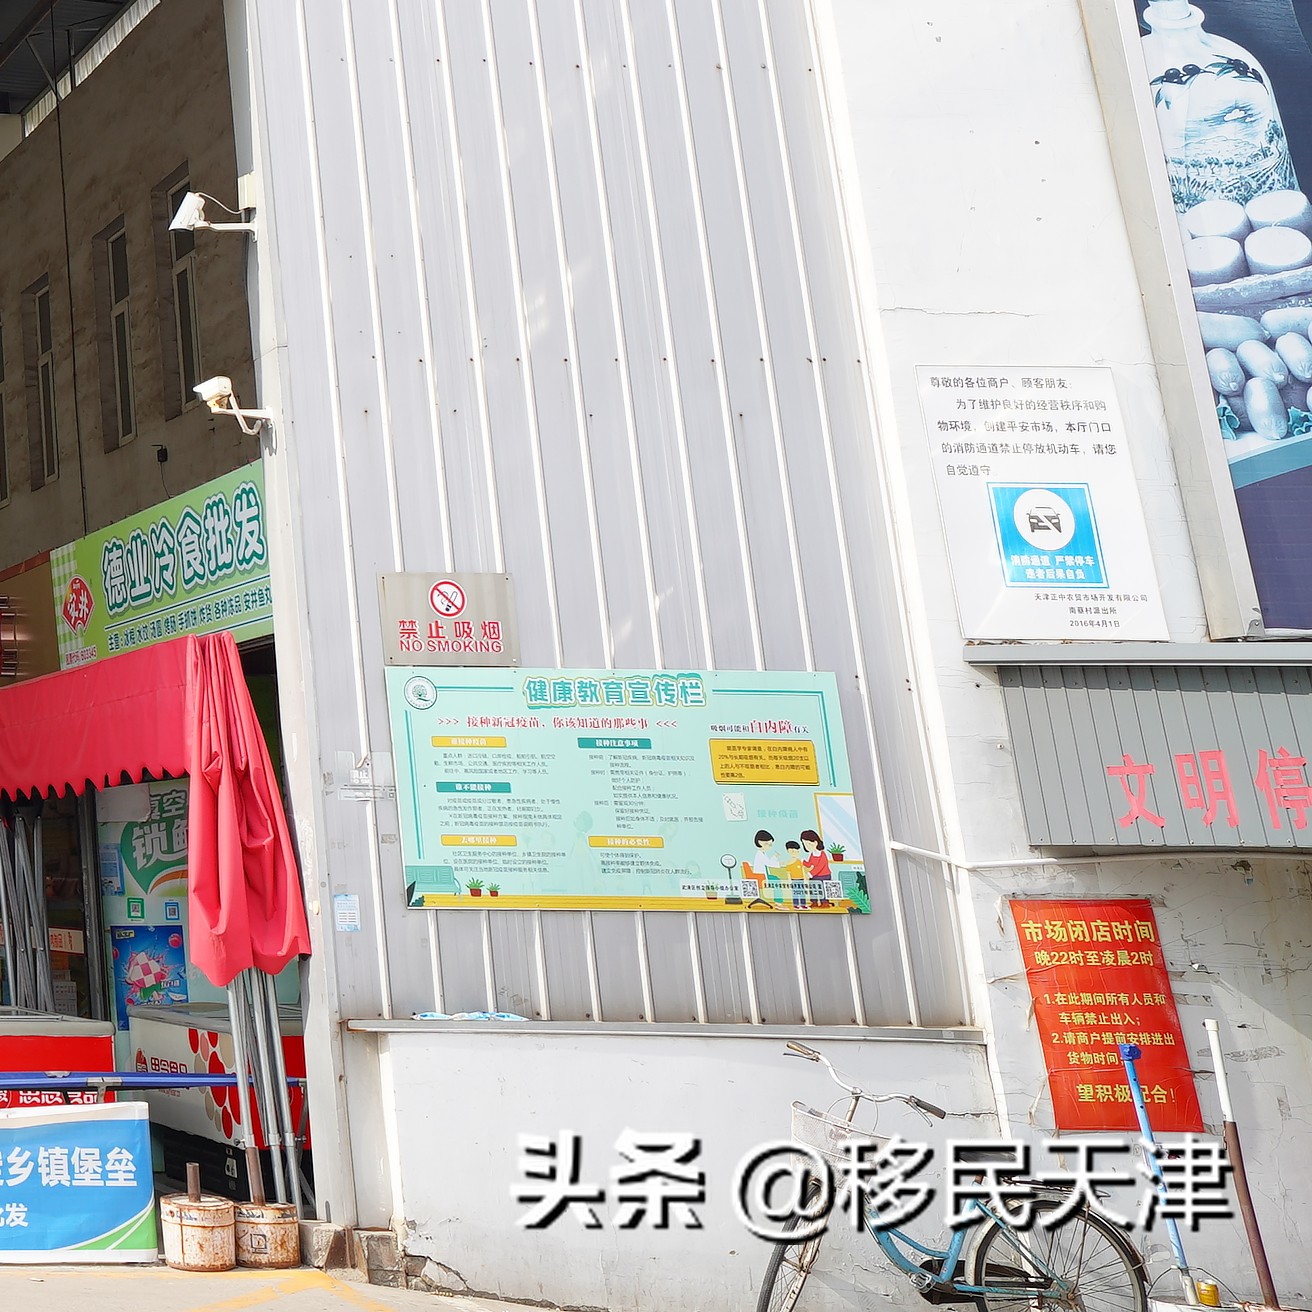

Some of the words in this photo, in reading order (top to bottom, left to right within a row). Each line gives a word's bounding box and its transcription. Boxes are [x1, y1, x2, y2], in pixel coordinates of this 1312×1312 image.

[101, 481, 267, 616] 德业冷食批发
[1010, 554, 1050, 567] 消防通道
[1055, 555, 1096, 567] 严禁停车
[1025, 568, 1086, 580] 违者后果自负
[398, 619, 502, 640] 禁止吸烟
[400, 639, 423, 652] NO
[426, 640, 503, 654] SMOKING
[525, 677, 705, 707] 健康教育宣传栏
[1021, 920, 1155, 943] 市场闭店时间
[1034, 950, 1154, 967] 晚22时至凌晨2时
[1044, 992, 1166, 1006] 1.在此期间所有人员和
[1051, 1032, 1175, 1046] 2.请商户提前安排进出
